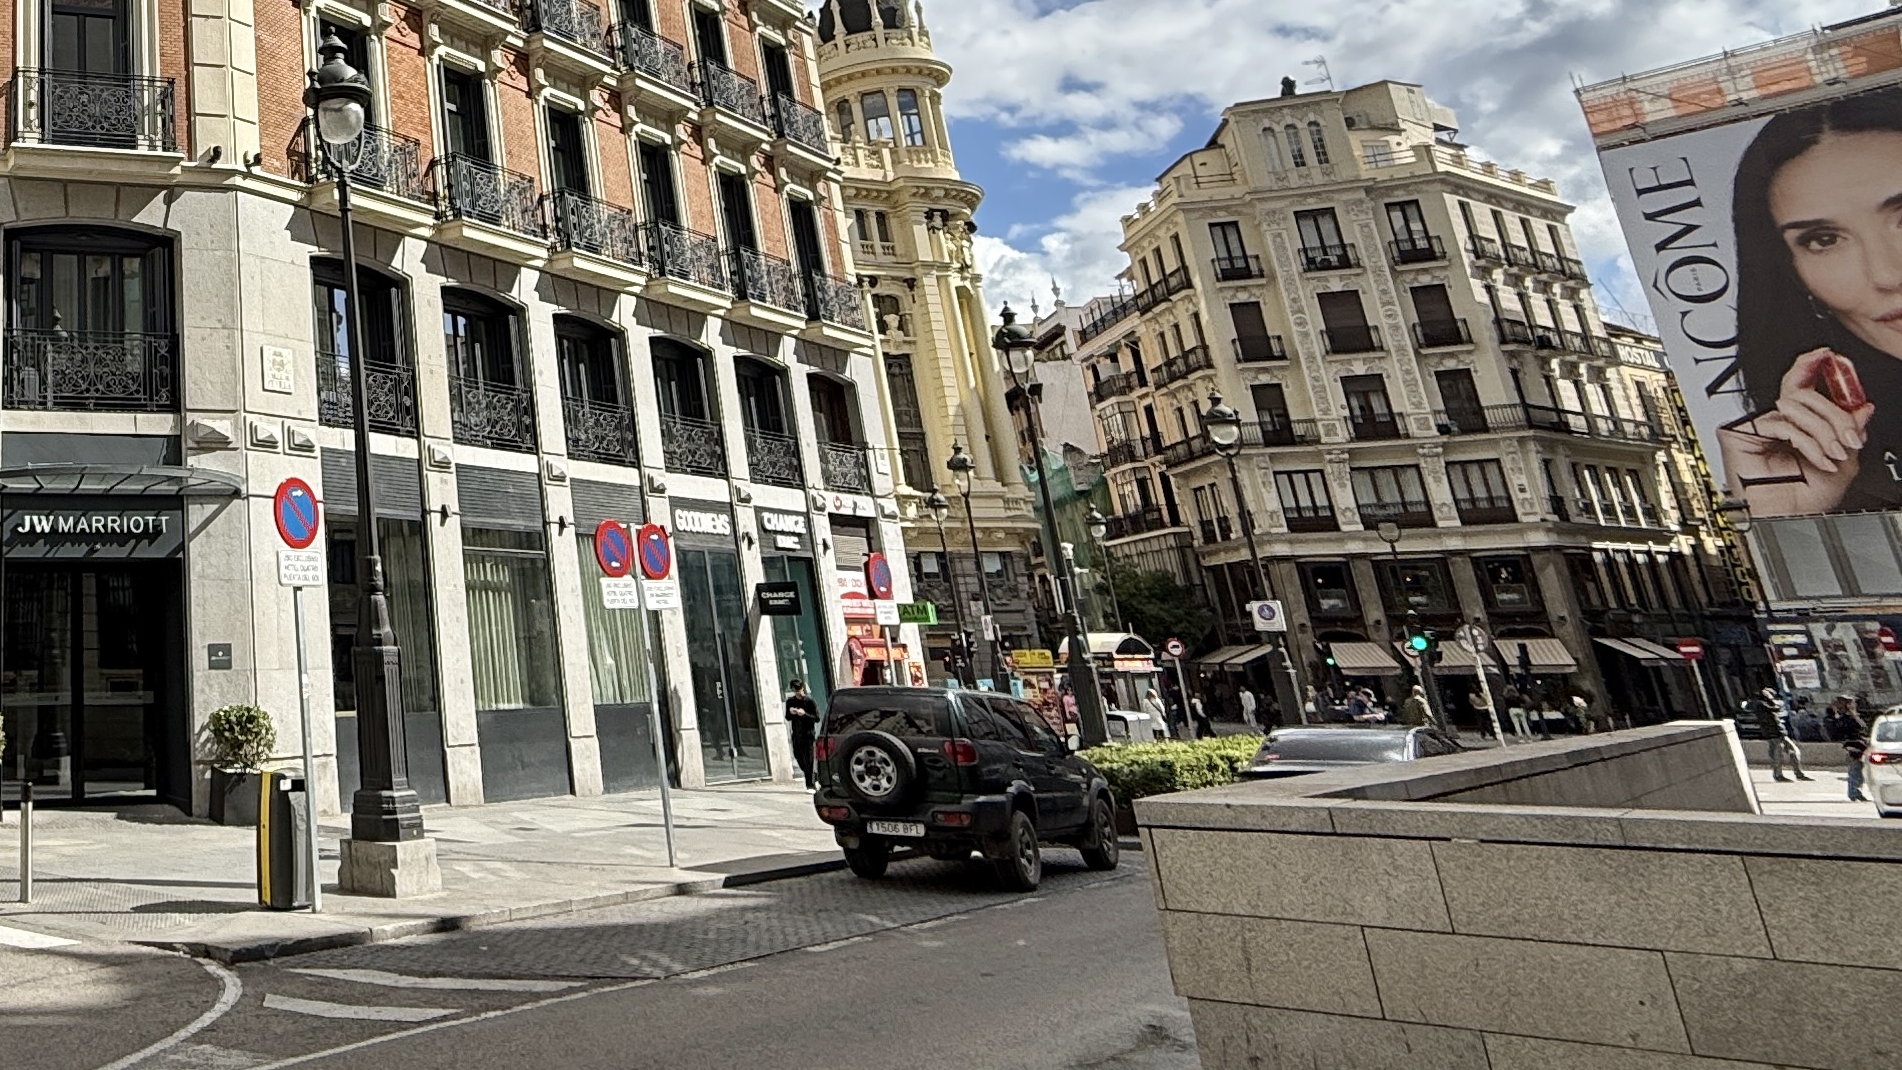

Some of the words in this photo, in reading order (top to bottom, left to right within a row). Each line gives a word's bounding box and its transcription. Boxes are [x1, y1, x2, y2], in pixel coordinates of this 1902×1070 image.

[1629, 156, 1809, 487] LANCÔME
[1617, 344, 1661, 369] HOSTAL
[17, 515, 54, 533] JW
[58, 515, 170, 534] MARRIOTT
[675, 509, 730, 535] GOODNEWS
[762, 511, 807, 534] CHANGE
[761, 591, 796, 599] CHANGE
[902, 603, 928, 617] ATM
